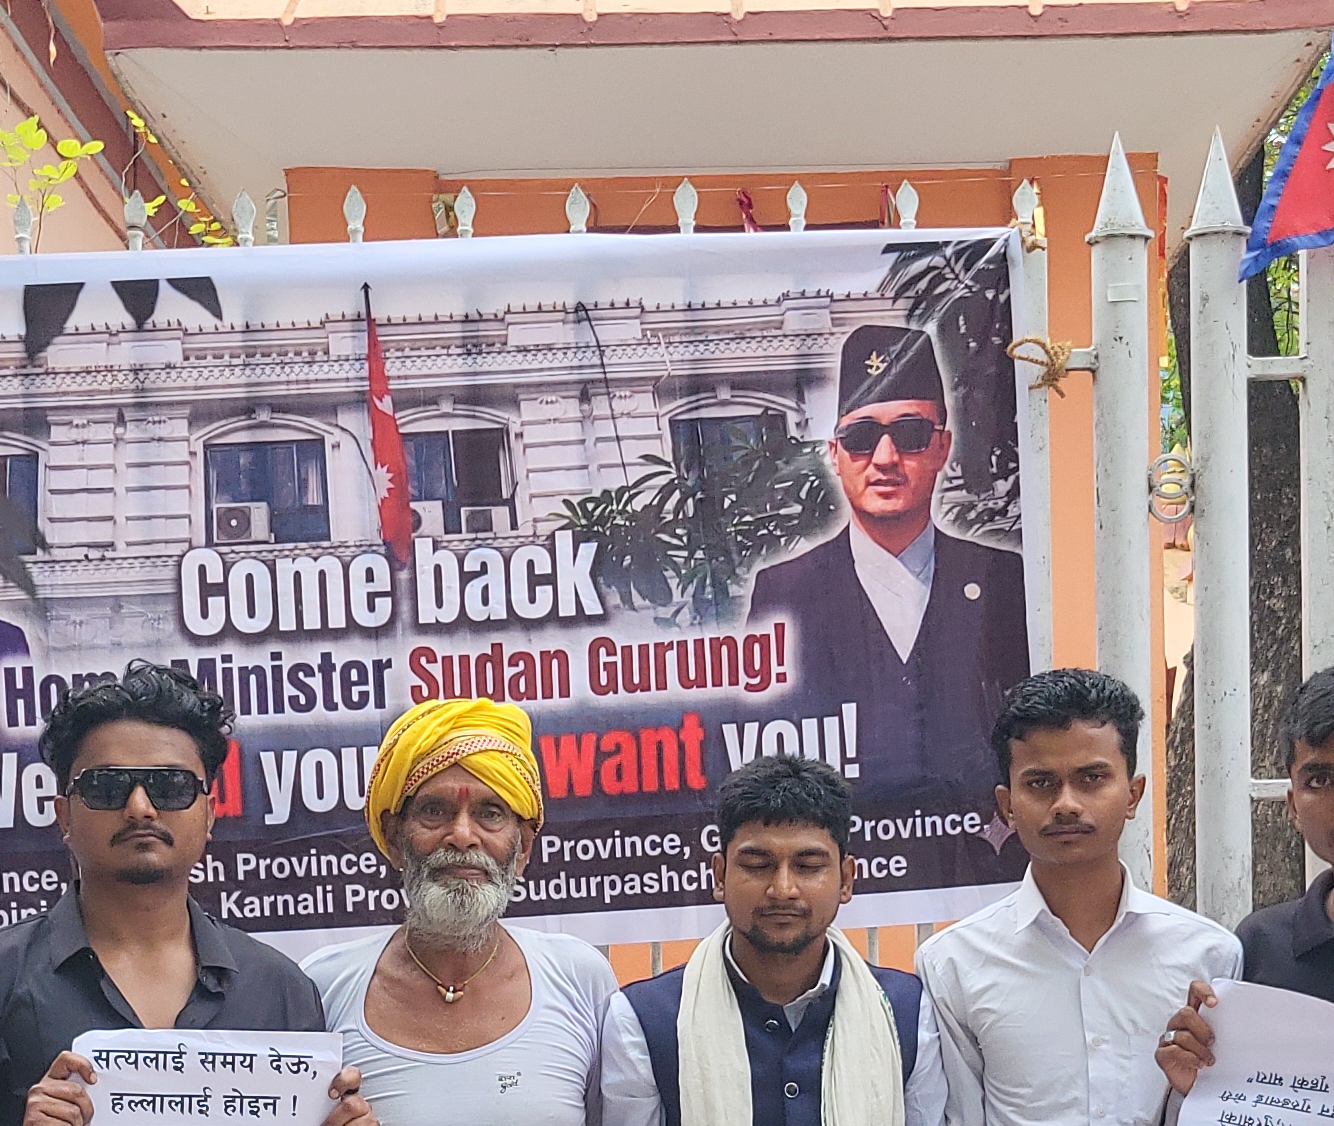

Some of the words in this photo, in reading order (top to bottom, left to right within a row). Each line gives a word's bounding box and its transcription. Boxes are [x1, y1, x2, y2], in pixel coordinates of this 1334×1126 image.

[180, 547, 393, 638] Come
[415, 529, 604, 624] back
[170, 650, 393, 717] Minister
[409, 639, 572, 706] Sudan
[588, 623, 788, 697] Gurung!
[259, 745, 379, 825] you
[540, 712, 707, 799] want
[236, 847, 387, 881] Province,
[541, 829, 691, 864] Province,
[220, 883, 334, 919] Karnali
[91, 1042, 187, 1074] सत्यलाई
[197, 1050, 258, 1074] समय
[268, 1046, 319, 1080] देऊ,
[109, 1086, 214, 1118] हल्लालाई
[222, 1087, 281, 1118] होइन
[290, 1095, 298, 1117] !
[1289, 1075, 1330, 1093] गृहको
[1251, 1093, 1311, 1114] गुरुङलाई
